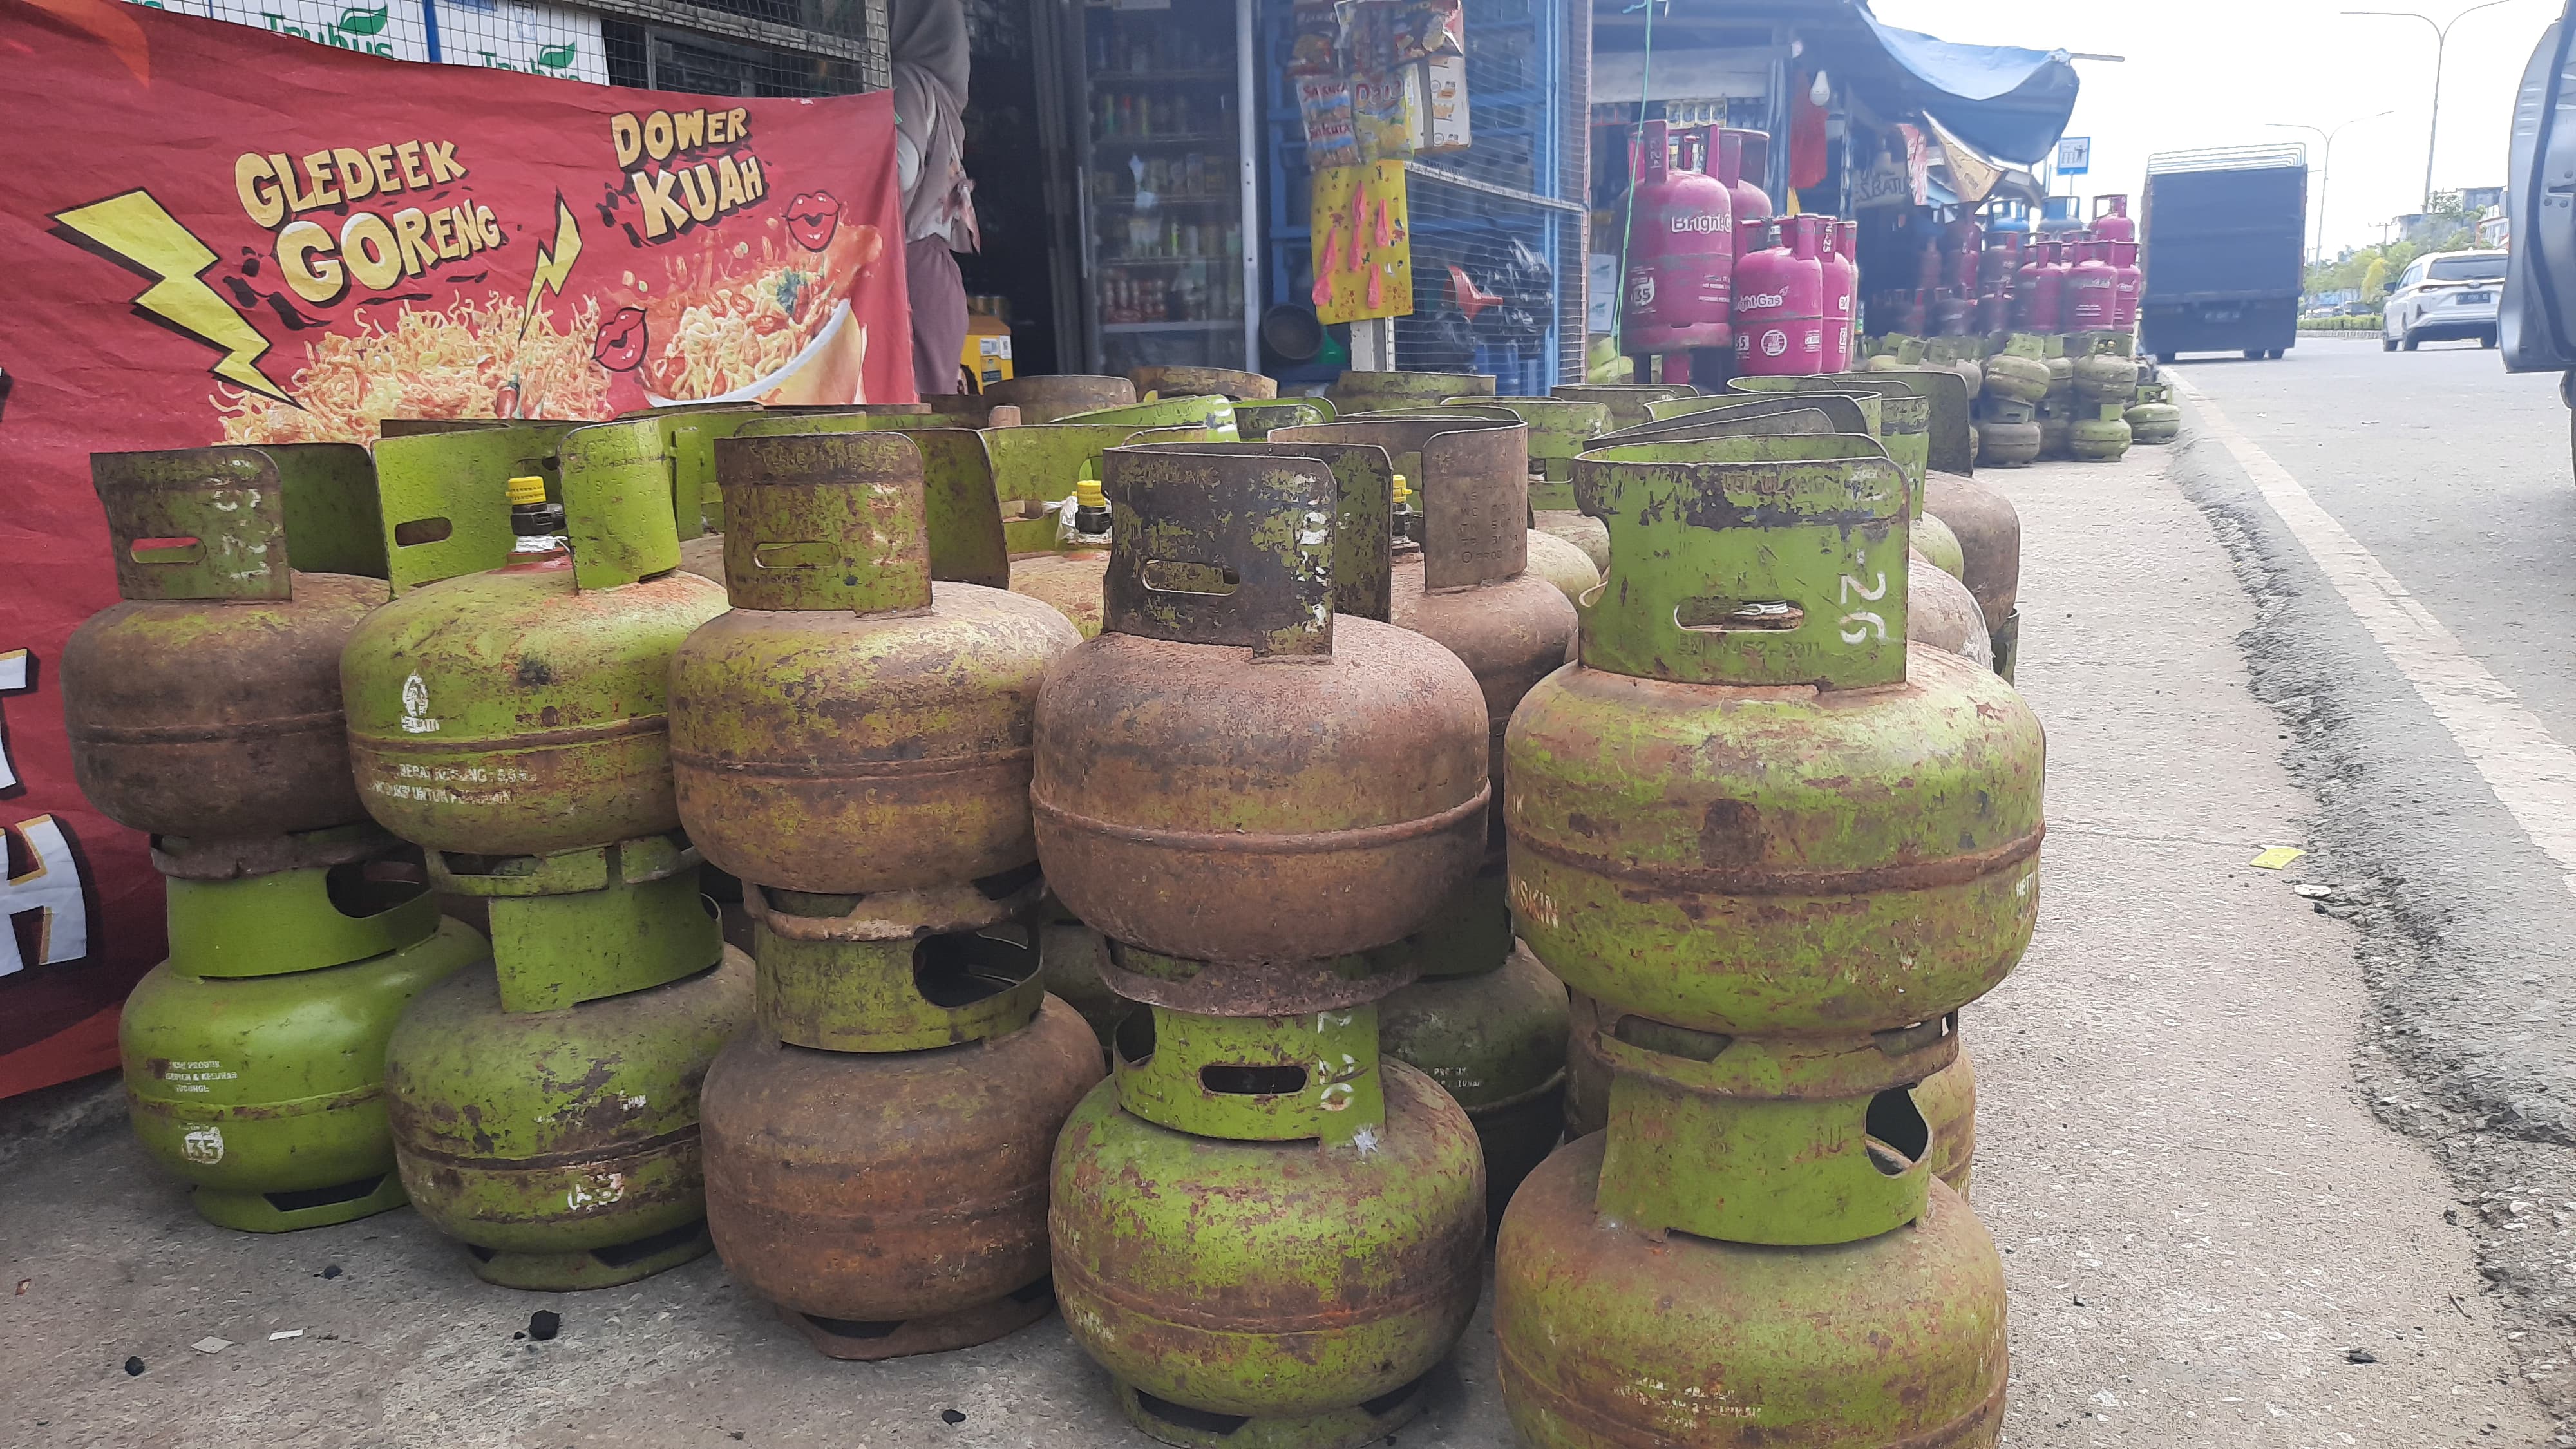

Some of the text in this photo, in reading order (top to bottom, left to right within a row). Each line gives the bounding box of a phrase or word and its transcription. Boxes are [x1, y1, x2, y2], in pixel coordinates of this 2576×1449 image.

[611, 107, 749, 169] DOWER
[235, 140, 468, 229] GLEDEEK
[632, 155, 765, 239] KUAH
[277, 200, 502, 303] GORENG
[1757, 294, 1783, 308] Gas
